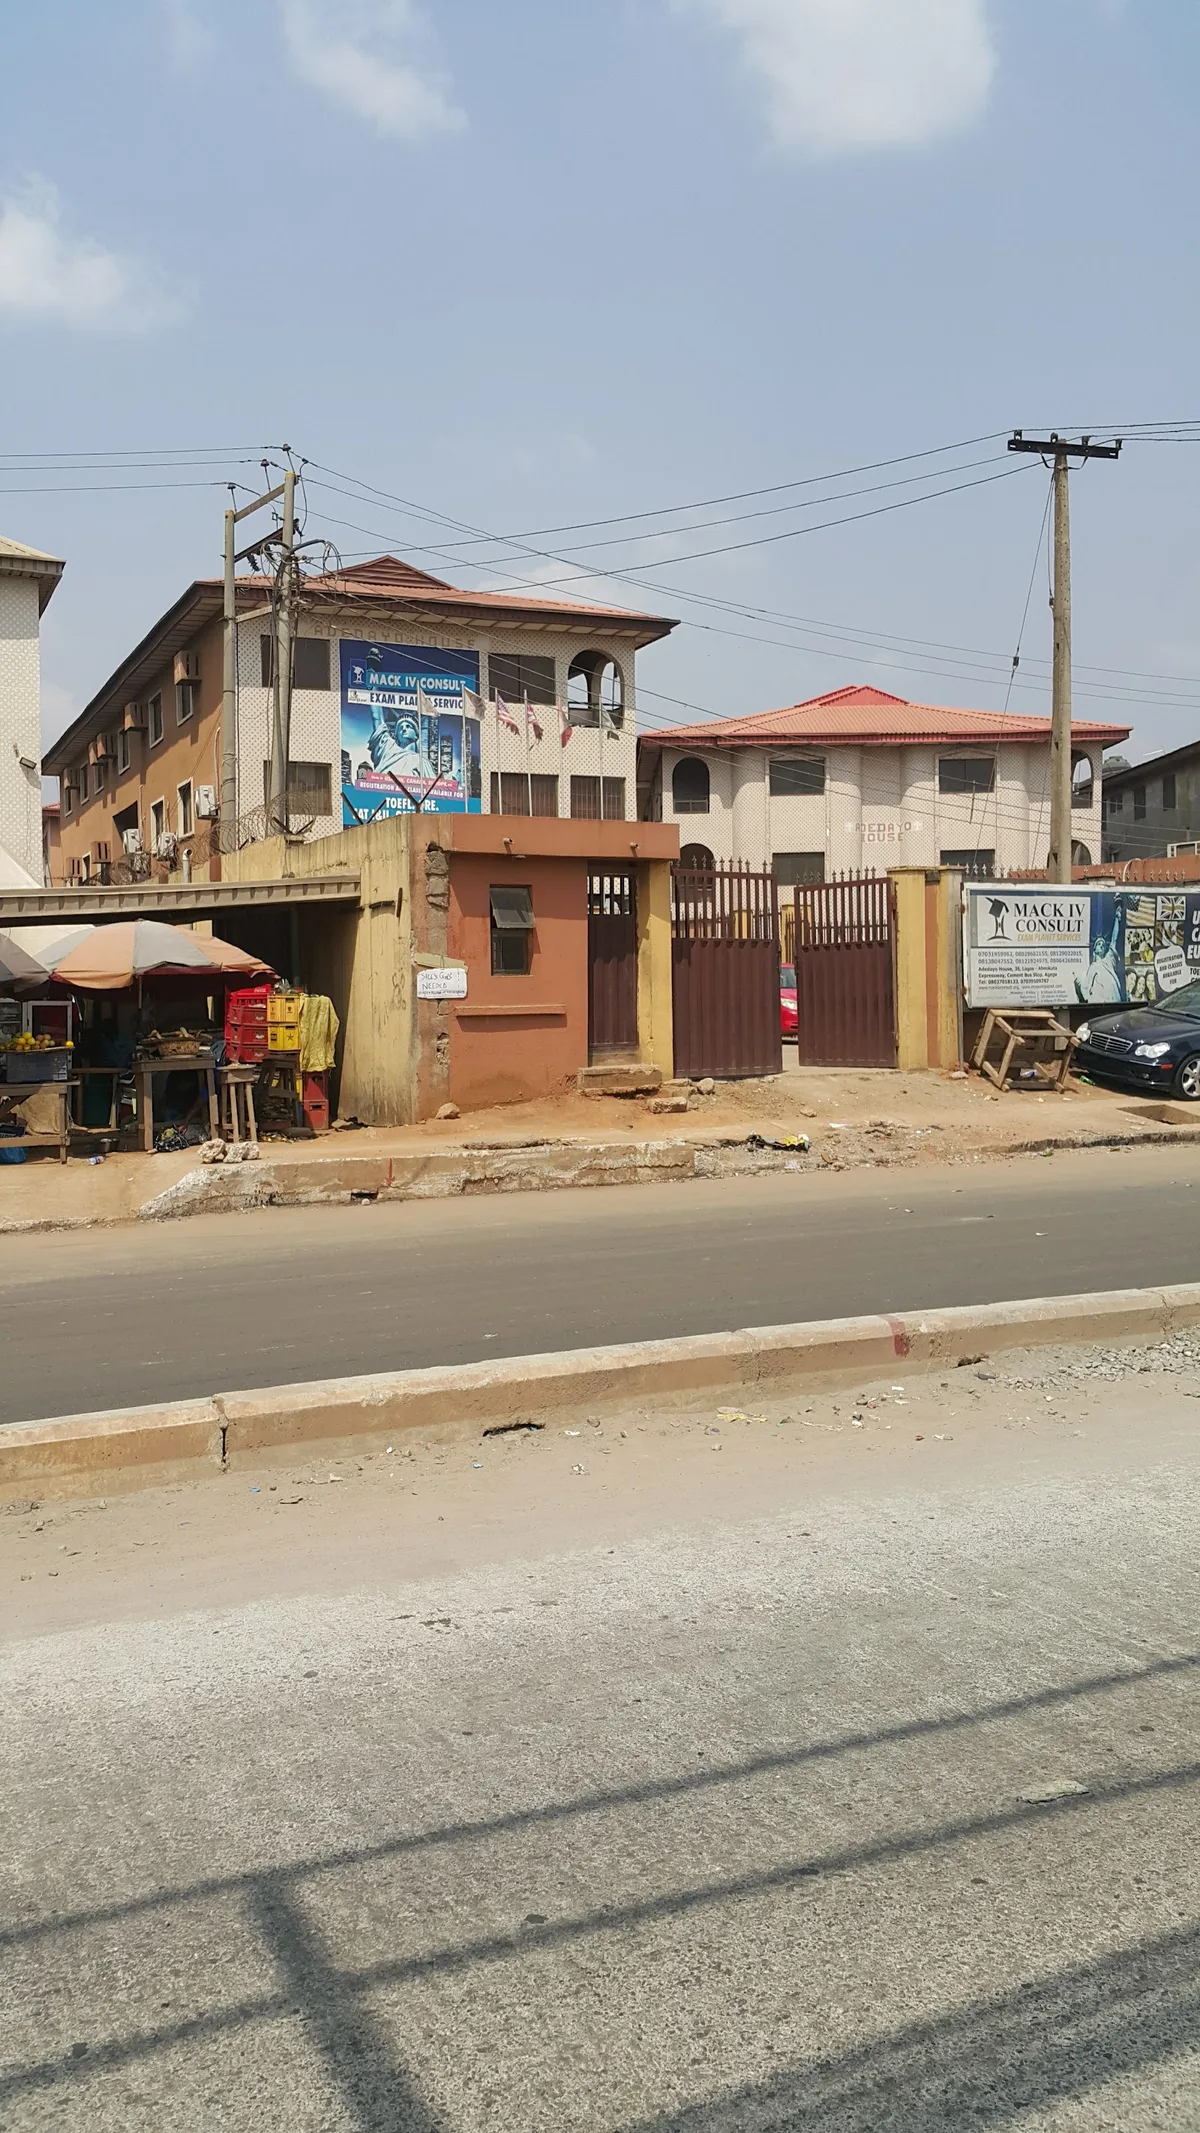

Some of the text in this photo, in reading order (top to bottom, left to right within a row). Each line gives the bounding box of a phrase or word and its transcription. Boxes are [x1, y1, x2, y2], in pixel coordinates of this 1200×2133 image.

[314, 624, 475, 648] ADEDAYO HOUSE
[369, 673, 466, 690] MACK IV CONSULT
[370, 693, 396, 704] EXAM
[399, 696, 431, 707] PLA
[434, 699, 463, 709] SERVIC
[360, 781, 394, 790] REGISTRATION
[407, 786, 427, 794] CLASSS
[855, 822, 911, 832] ADEDAYO
[1013, 903, 1086, 917] MACK IV
[1016, 919, 1084, 932] CONSULT
